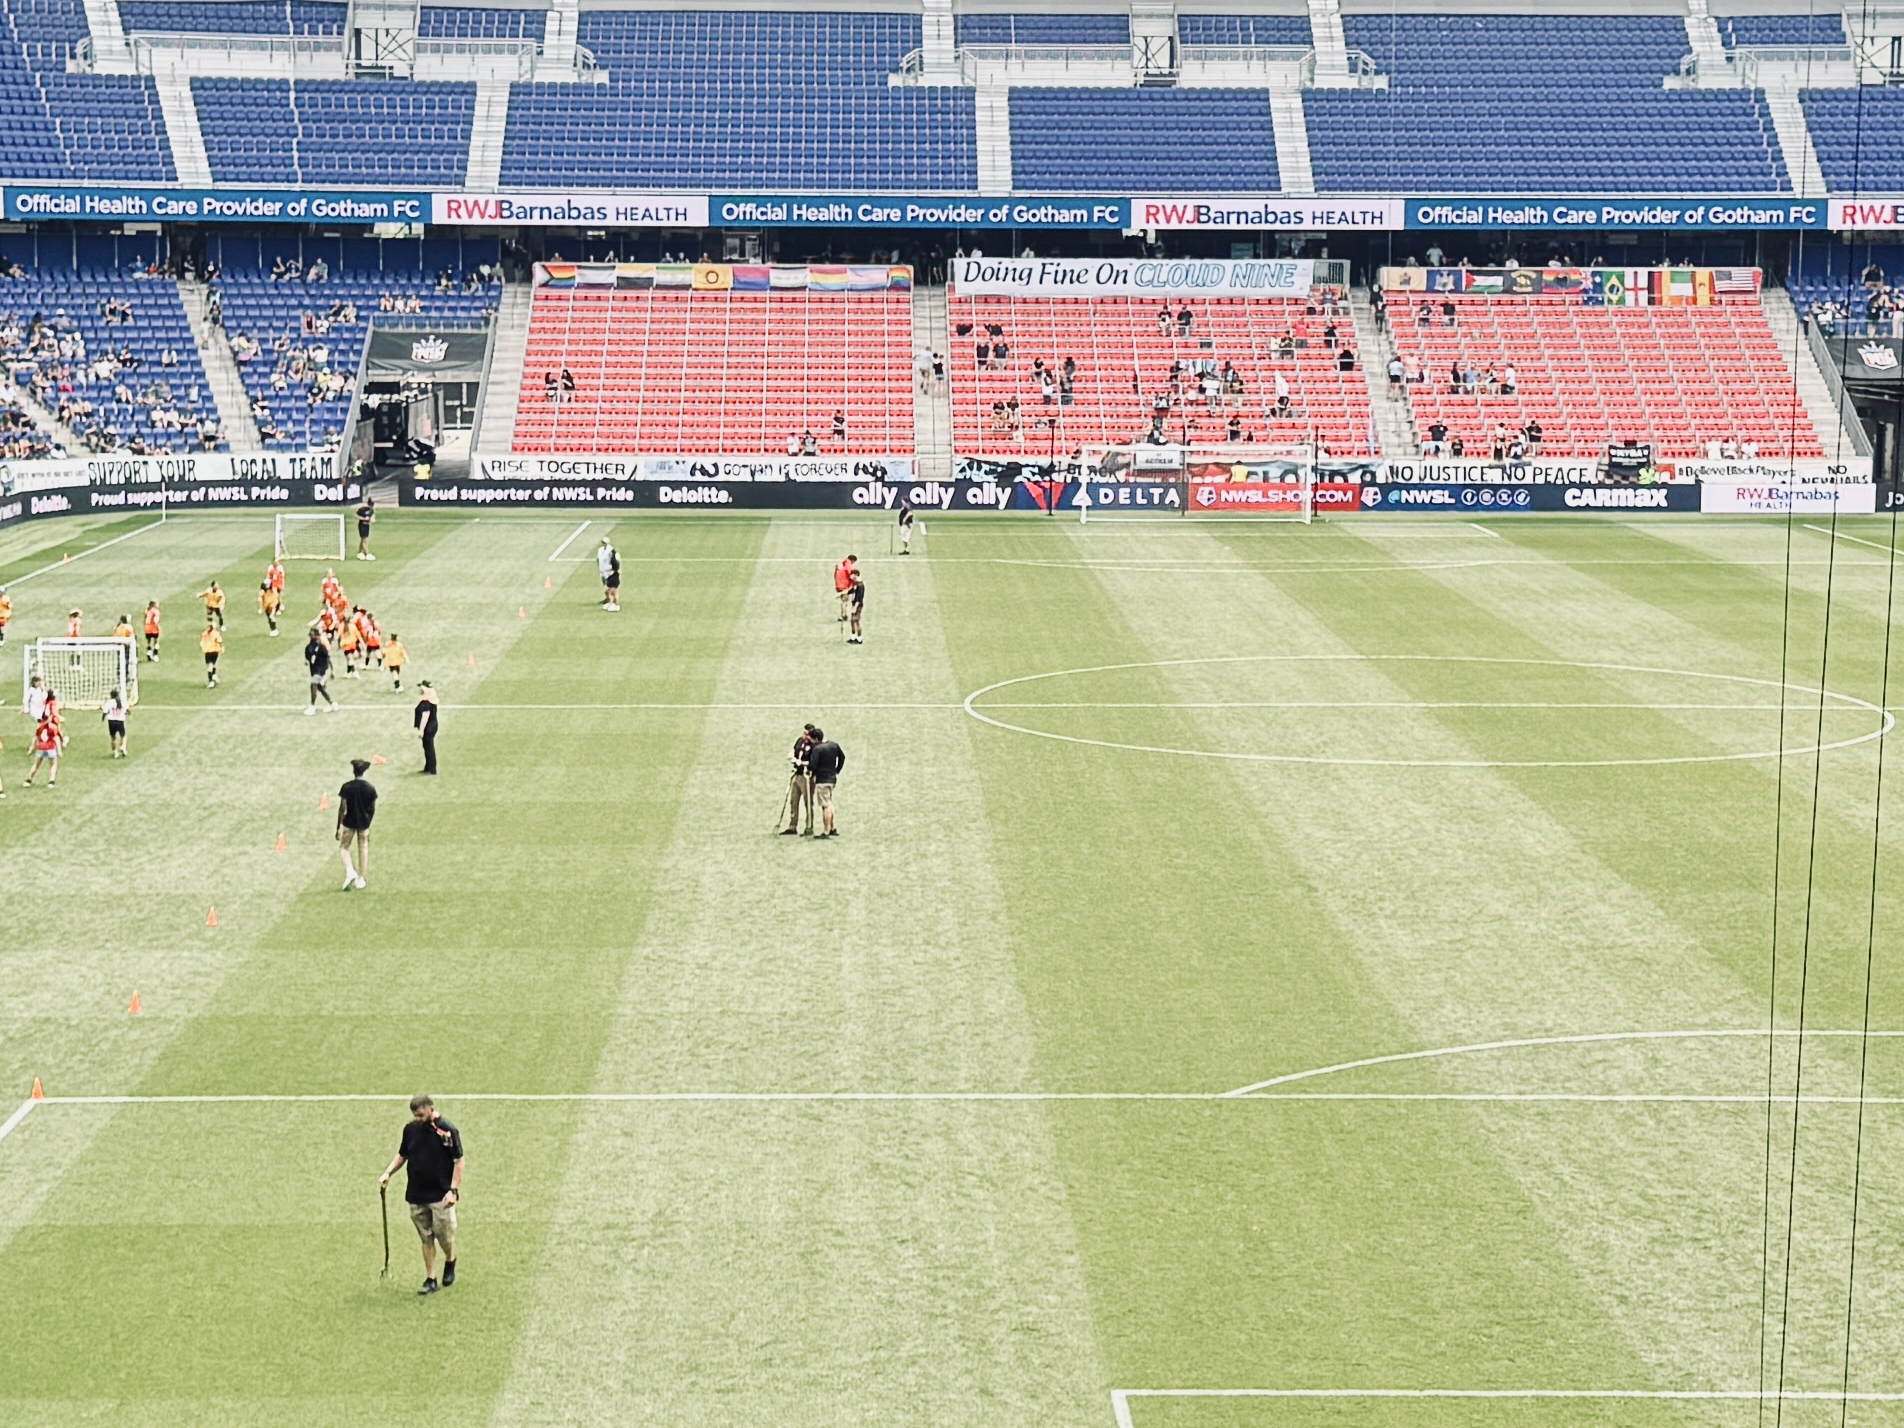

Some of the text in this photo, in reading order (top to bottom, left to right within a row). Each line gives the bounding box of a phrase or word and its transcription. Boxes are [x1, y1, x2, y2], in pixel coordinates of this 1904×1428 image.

[16, 193, 420, 218] Official Health Care Provider of Gotham FC
[616, 207, 688, 223] HEALTH
[1311, 210, 1384, 226] HEALTH
[963, 260, 1297, 288] Doing Fine On CLOUD NINE
[87, 459, 149, 485] SUPPORT
[156, 458, 196, 482] YOUR
[230, 458, 277, 481] LOCAL
[289, 457, 333, 481] TEAM
[491, 460, 626, 476] RISE TOGETHER
[1389, 465, 1414, 482] NO
[1501, 465, 1526, 482] NO
[1827, 465, 1848, 475] NO
[90, 485, 289, 507] Proud supporter of NWSL Pride
[852, 481, 899, 510] ally
[909, 481, 956, 510] ally
[966, 481, 1012, 510] ally
[1098, 489, 1181, 507] DELTA
[1219, 489, 1354, 504] NWSLSHOP.COM
[1388, 489, 1455, 504] @NWSL
